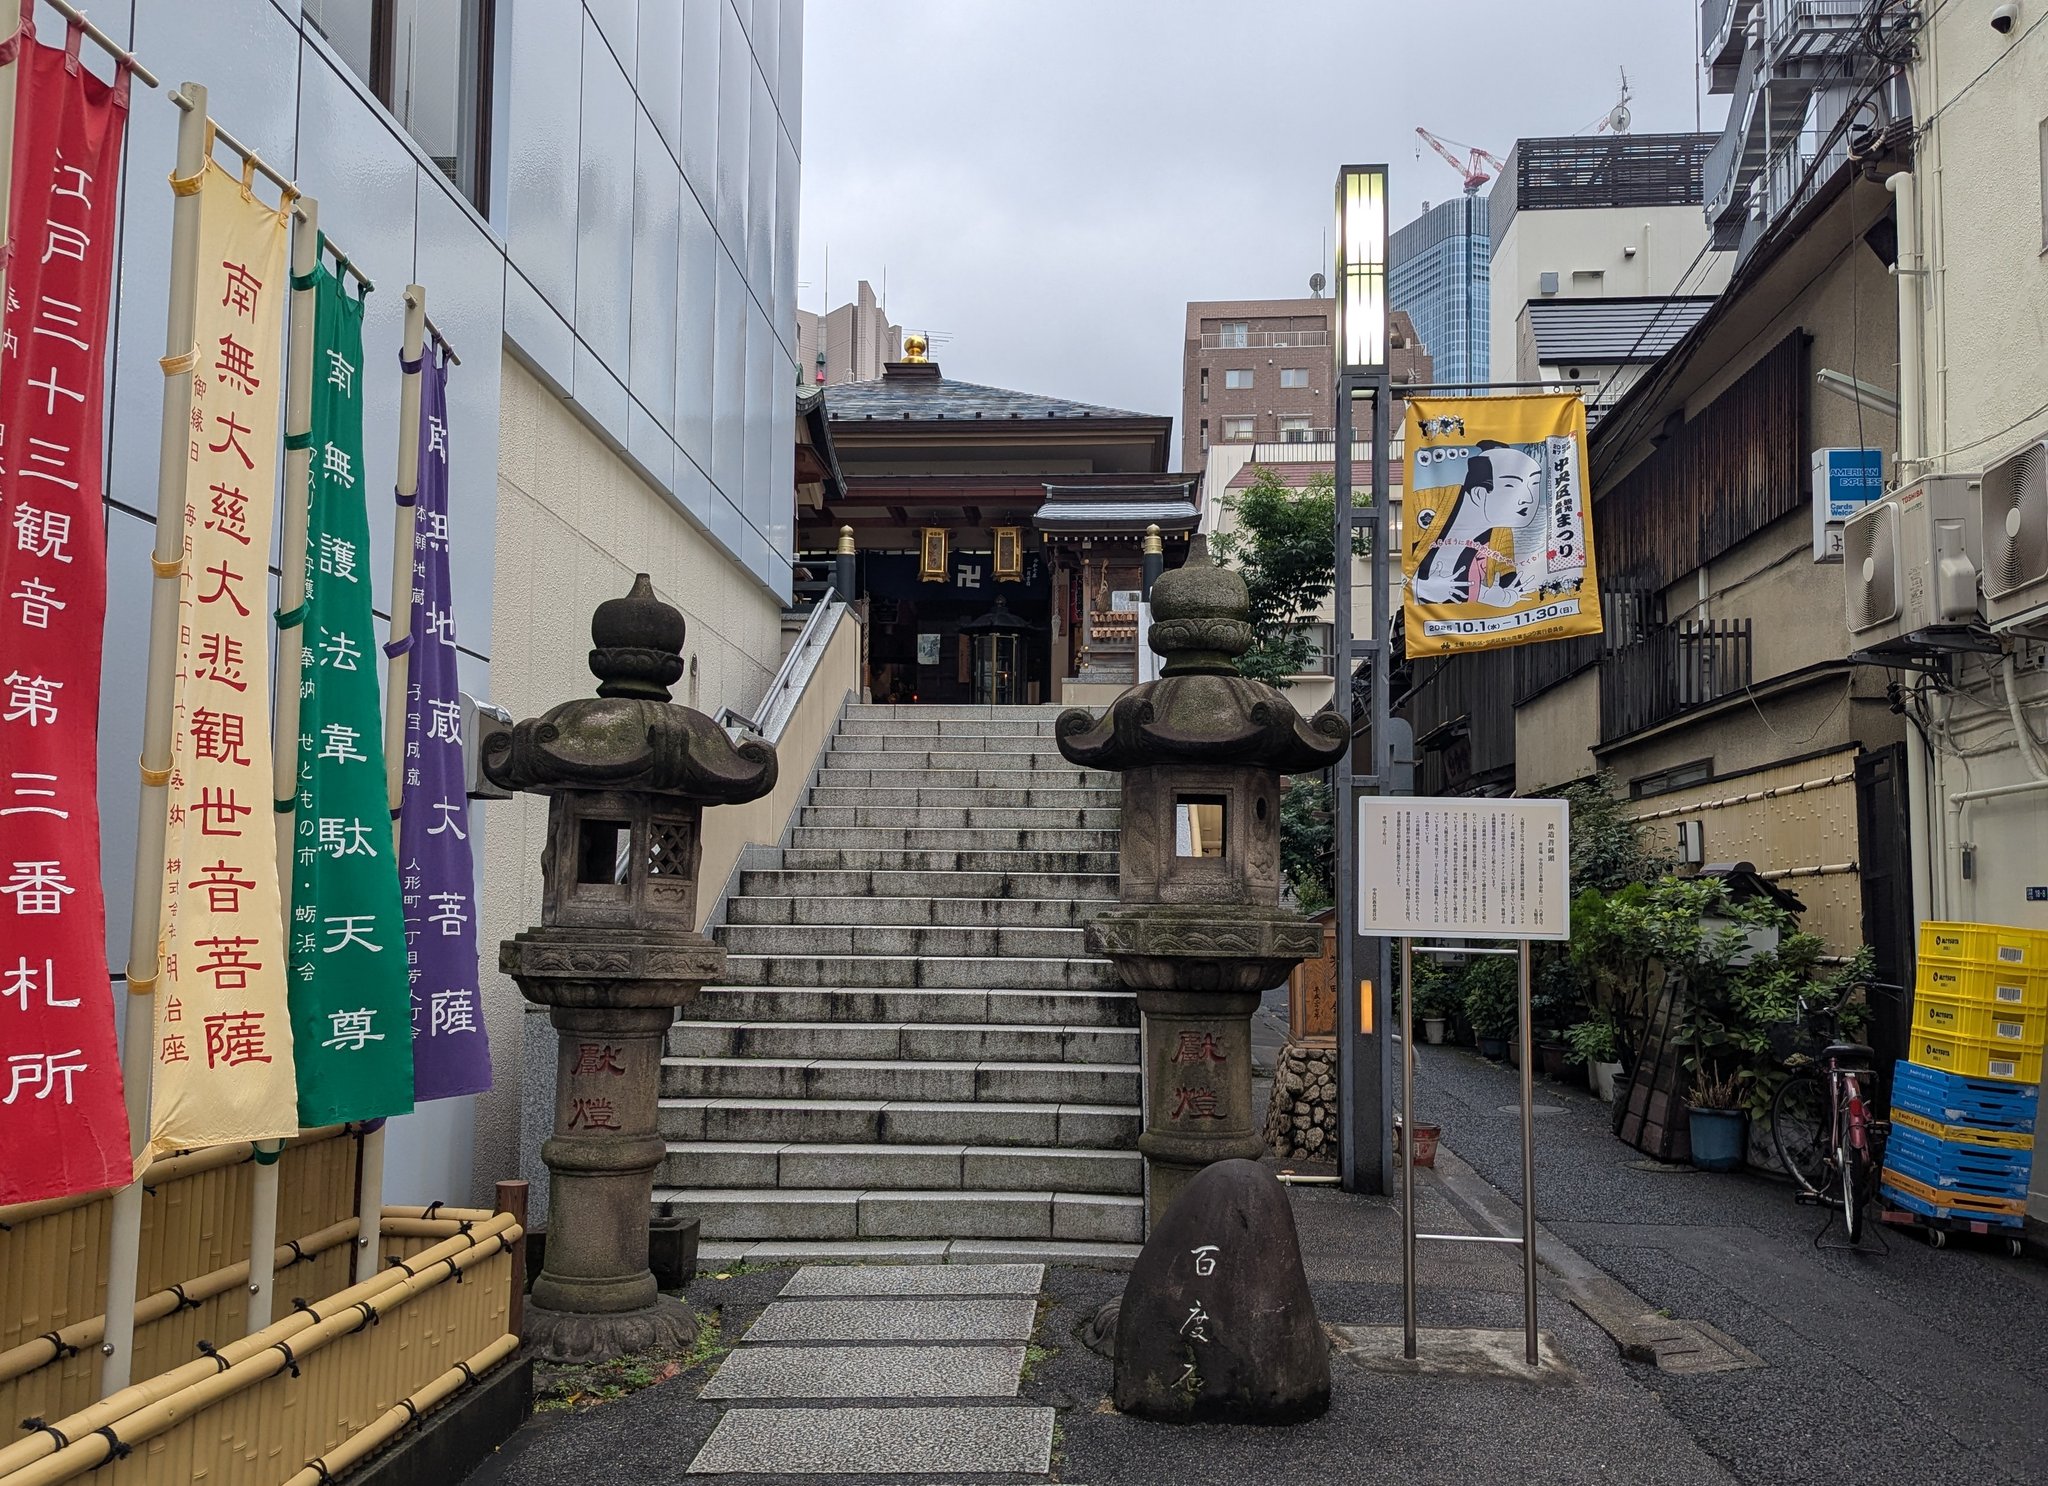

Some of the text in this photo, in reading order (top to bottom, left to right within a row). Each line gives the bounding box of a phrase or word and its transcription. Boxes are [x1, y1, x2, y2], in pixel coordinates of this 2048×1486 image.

[190, 374, 207, 462] 御縁日
[1830, 467, 1879, 477] AMERICAN
[1839, 477, 1882, 487] EXPRESS
[1901, 489, 1923, 504] TOSHIBA
[0, 147, 93, 1104] 江戸三十三観音第三番札所
[188, 261, 274, 1069] 南無大慈大悲観世音菩薩
[299, 646, 315, 699] 奉納
[318, 349, 386, 1051] 南無護法韋駄天尊
